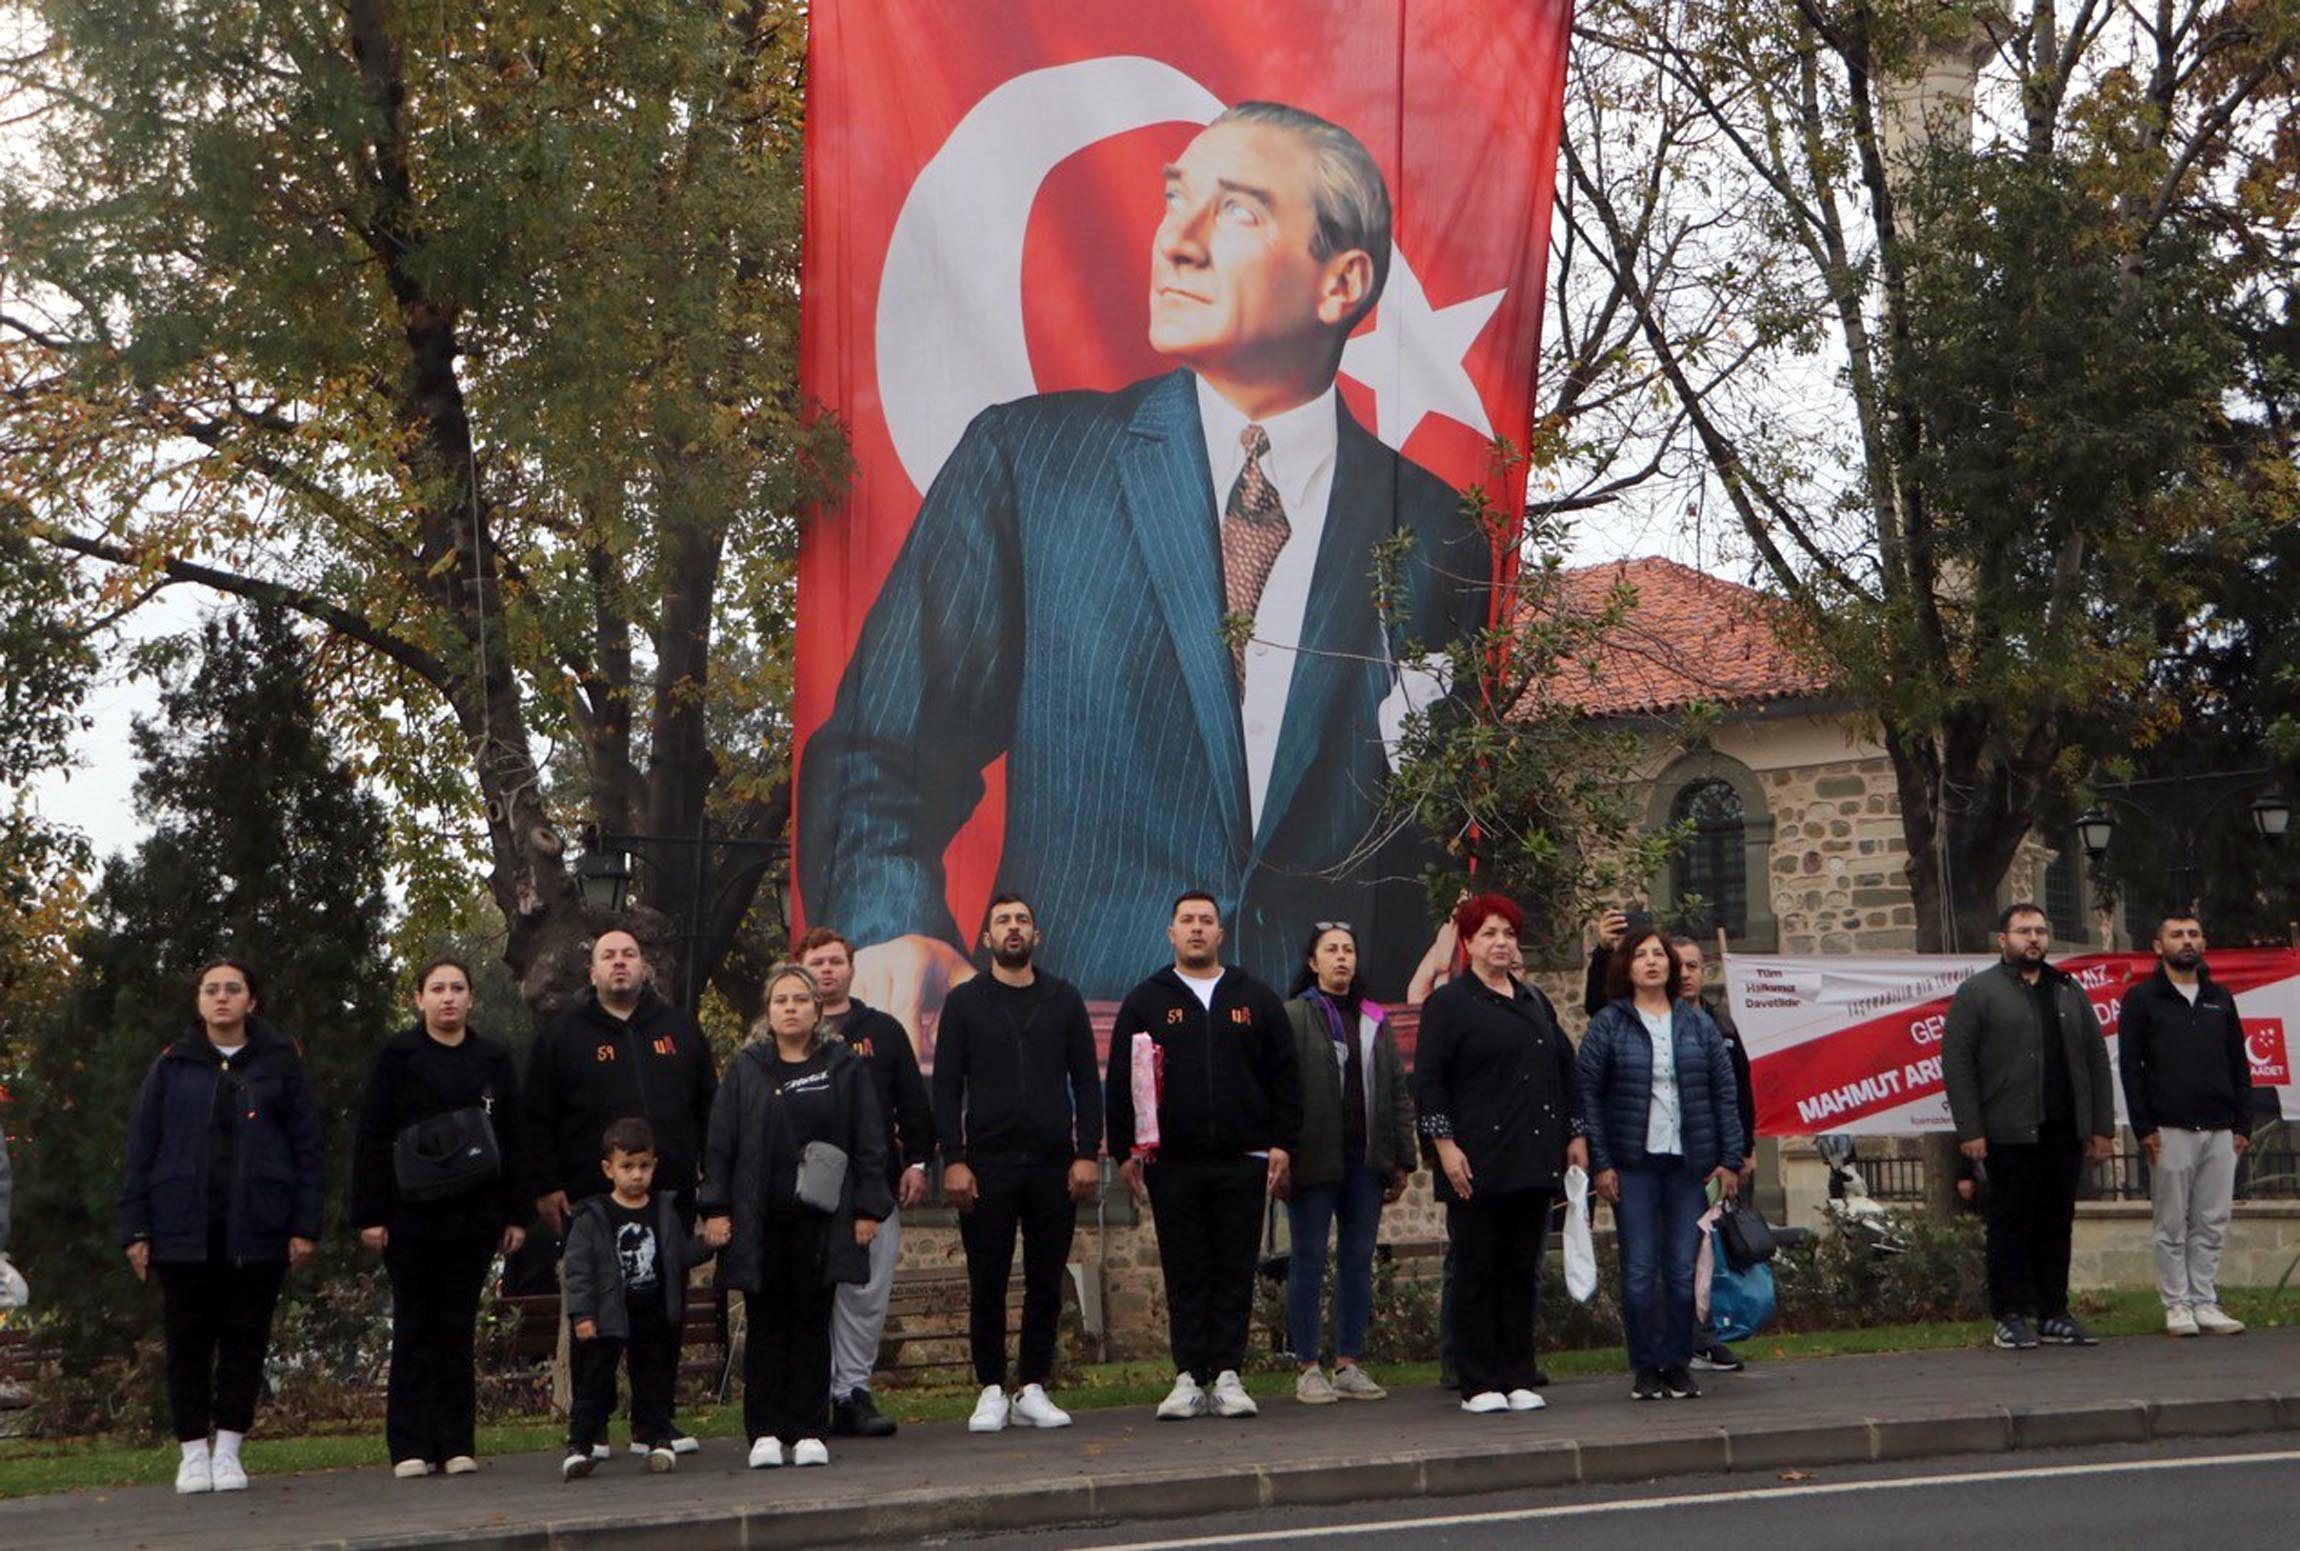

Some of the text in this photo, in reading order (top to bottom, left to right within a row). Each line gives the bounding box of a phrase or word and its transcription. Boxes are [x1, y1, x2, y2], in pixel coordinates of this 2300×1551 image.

[1756, 968, 1783, 978] Tüm
[1165, 1007, 1184, 1024] 59
[597, 1043, 616, 1061] 59
[1796, 1069, 1901, 1123] MAHMUT
[1904, 1055, 1944, 1088] ARI
